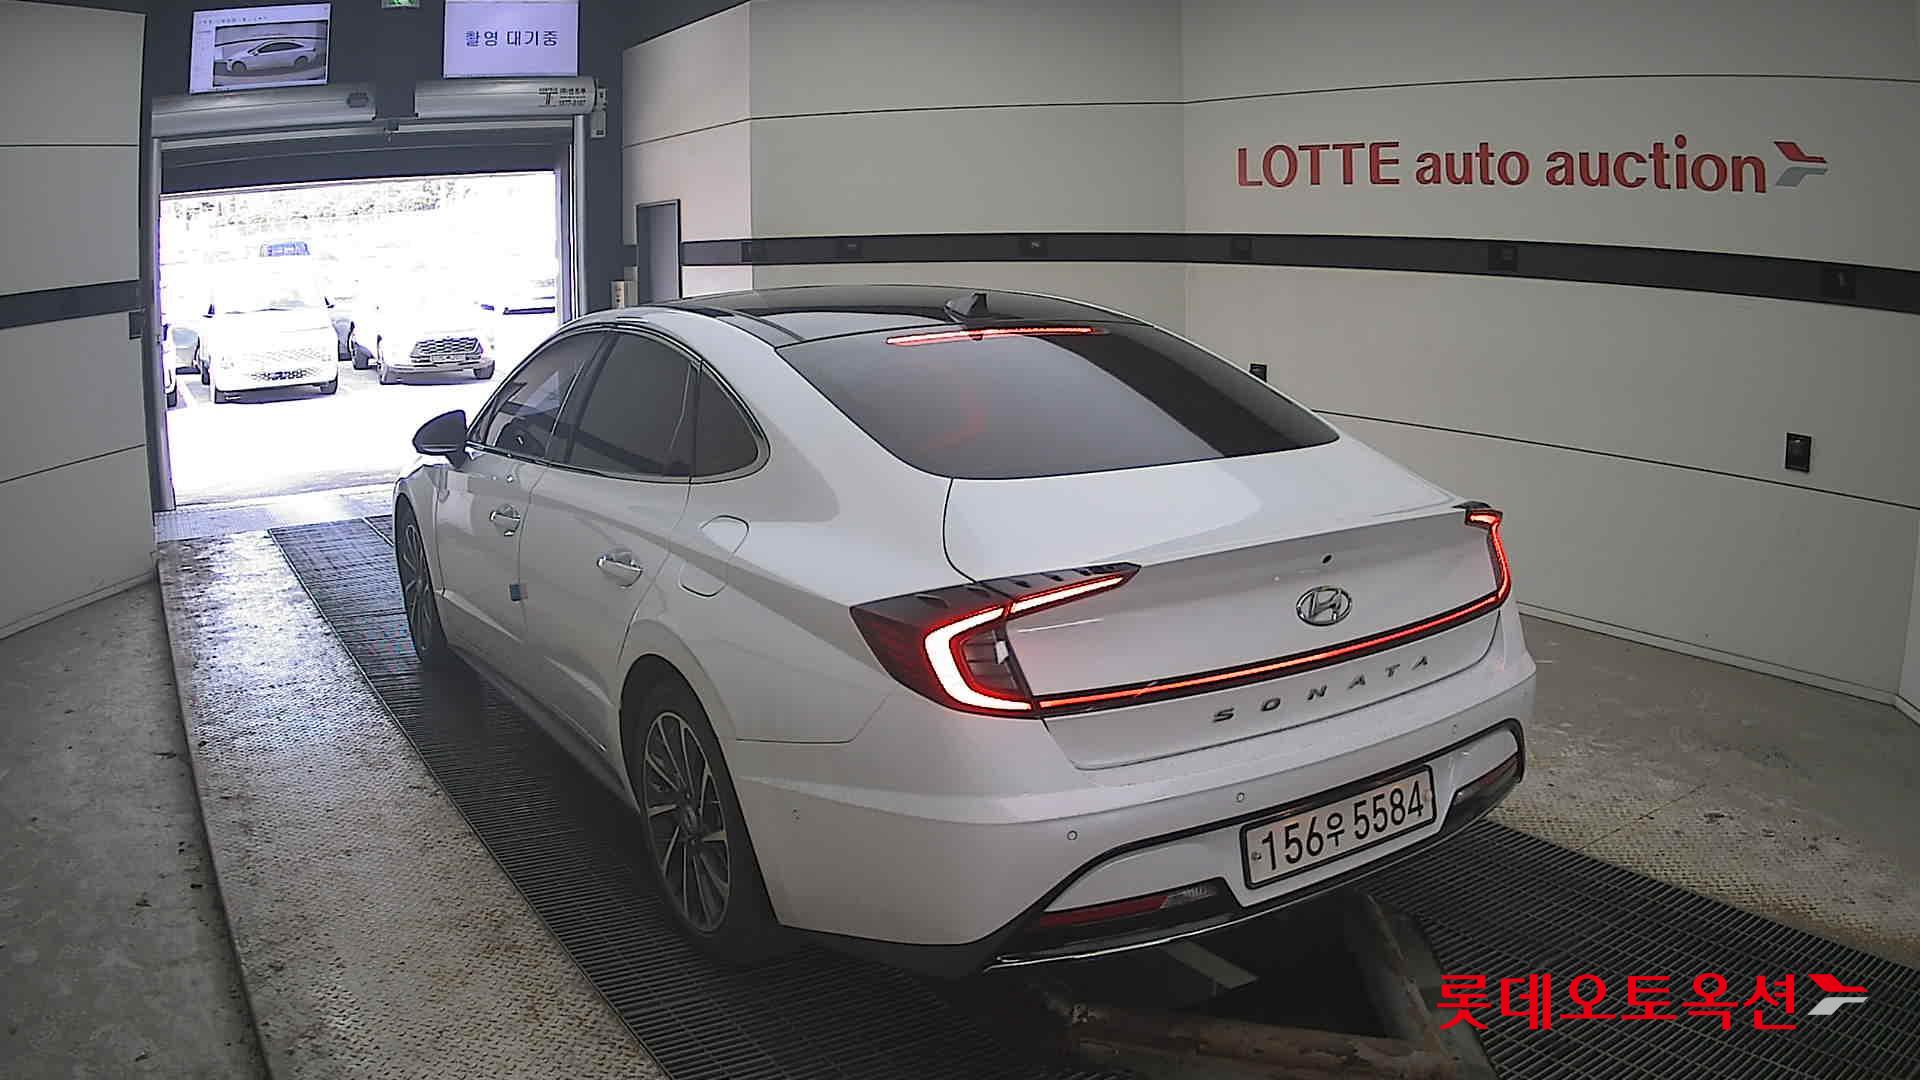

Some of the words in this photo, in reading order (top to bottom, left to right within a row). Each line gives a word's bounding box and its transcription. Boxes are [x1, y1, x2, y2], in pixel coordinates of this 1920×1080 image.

[507, 30, 558, 46] 대기중
[1237, 141, 1400, 187] LOTTE
[1415, 142, 1530, 185] auto
[1545, 134, 1767, 193] auction
[1212, 656, 1428, 722] SONATA
[1262, 812, 1345, 871] 156우
[1353, 780, 1424, 840] 5584
